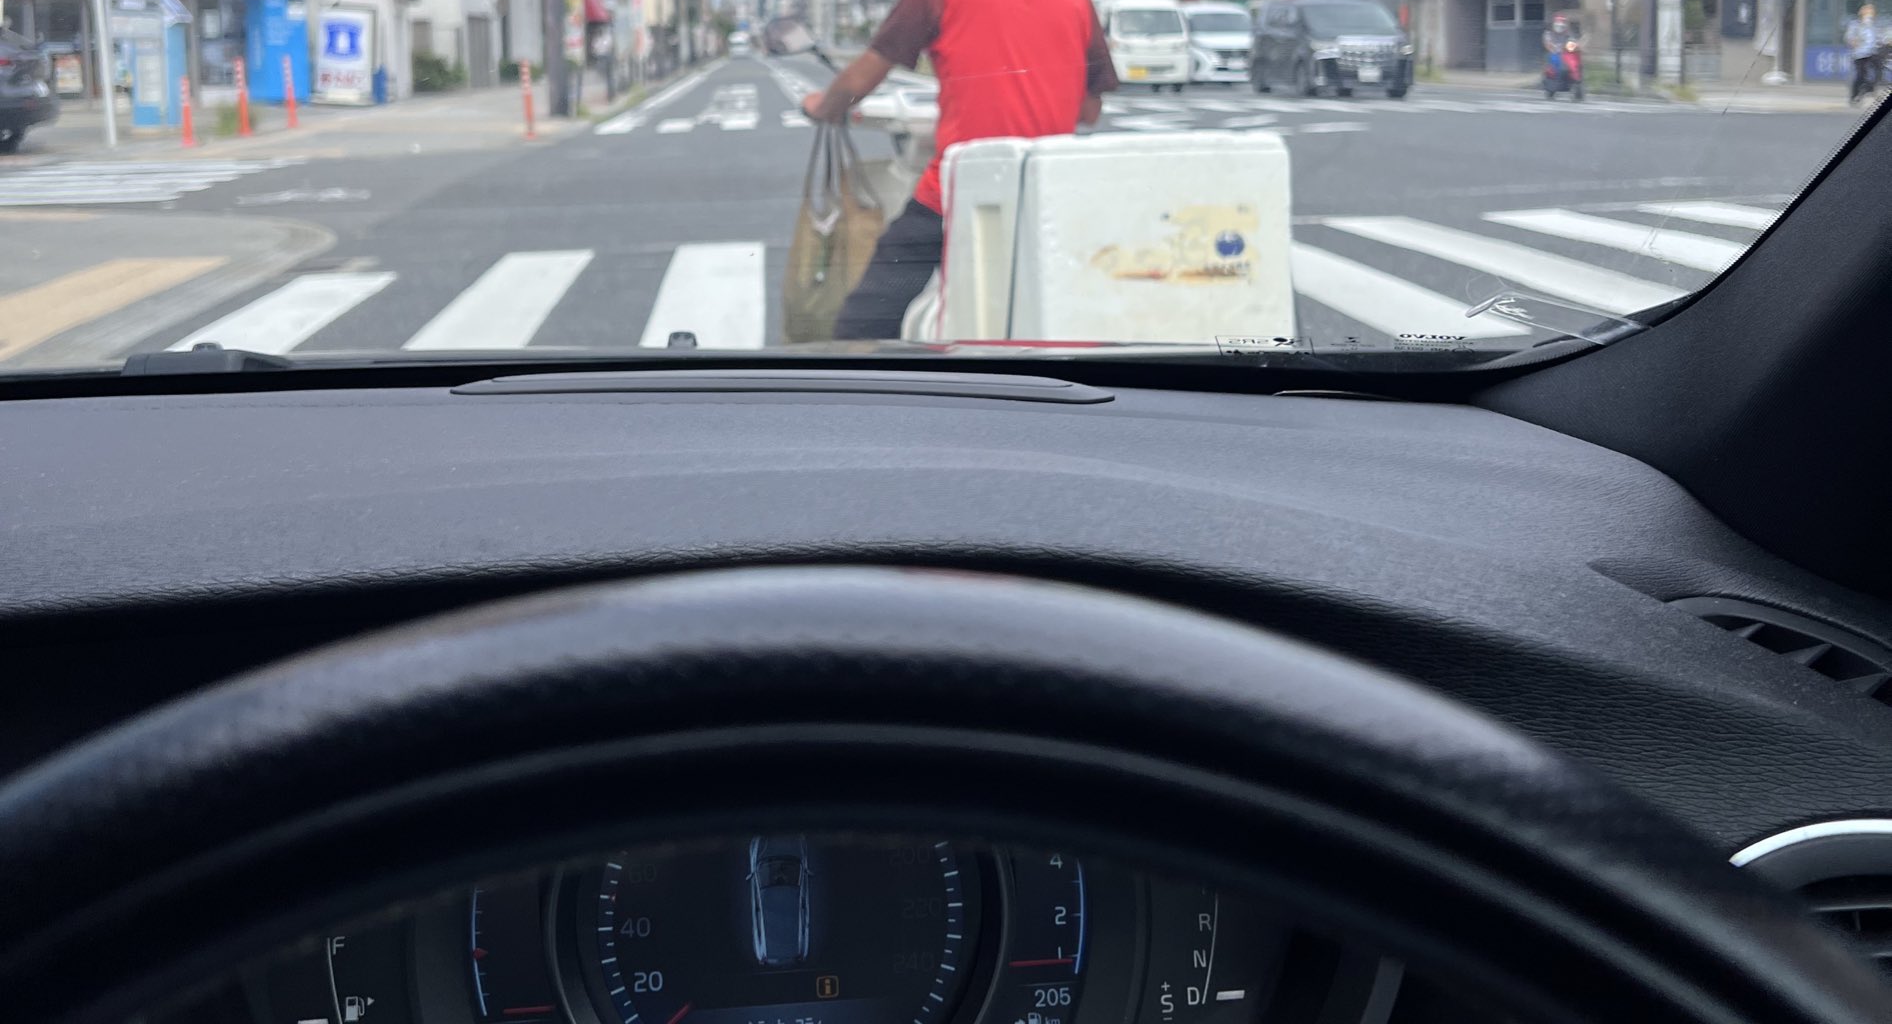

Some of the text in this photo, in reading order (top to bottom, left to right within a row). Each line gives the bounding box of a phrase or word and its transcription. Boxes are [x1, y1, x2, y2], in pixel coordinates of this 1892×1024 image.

[1049, 853, 1063, 869] 4
[1054, 906, 1067, 925] 2
[1198, 913, 1211, 932] R
[620, 916, 651, 938] 40
[332, 937, 346, 955] F
[1193, 949, 1207, 968] N
[634, 971, 663, 993] 20
[1034, 986, 1071, 1008] 205
[1160, 994, 1174, 1014] S
[1187, 986, 1200, 1006] D
